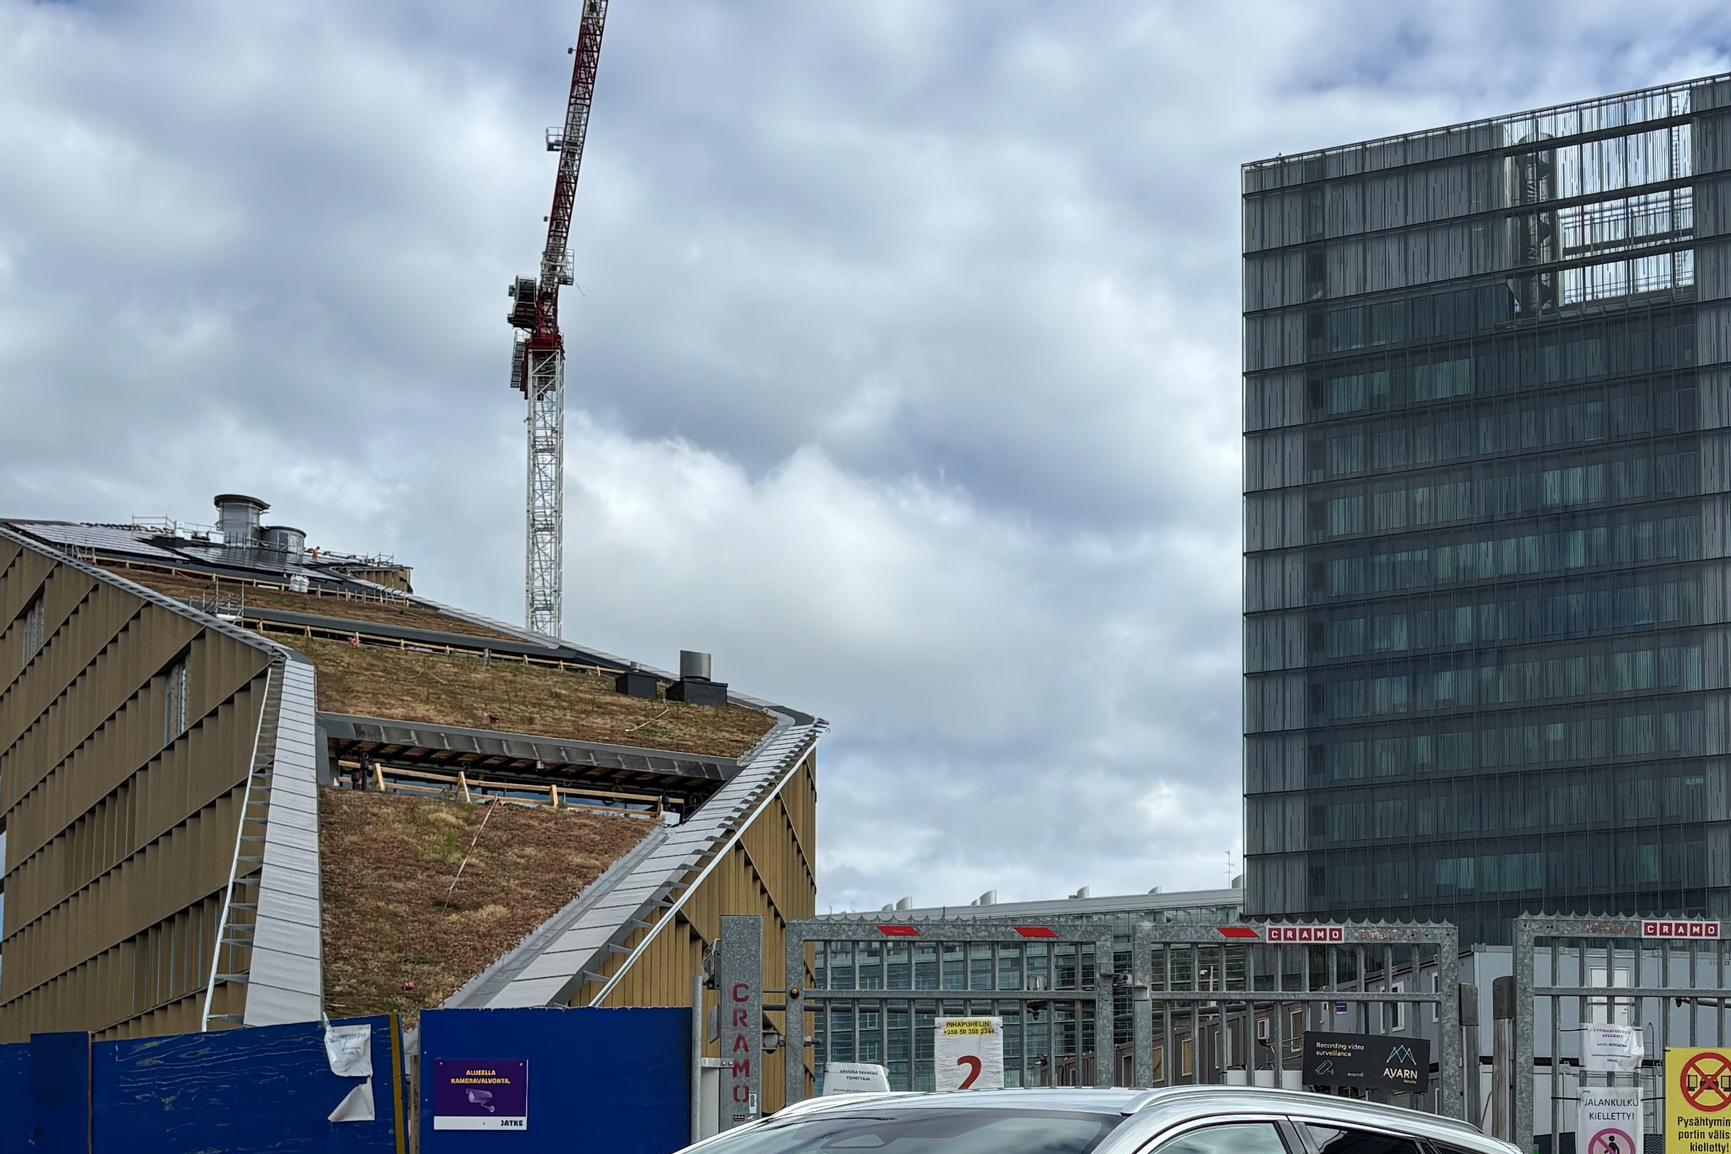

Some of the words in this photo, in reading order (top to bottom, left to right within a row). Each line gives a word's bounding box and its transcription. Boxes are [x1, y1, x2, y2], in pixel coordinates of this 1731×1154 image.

[1270, 929, 1340, 940] CRAMO
[1646, 925, 1715, 935] CRAMO
[732, 983, 750, 1103] CRAMO
[1316, 1042, 1347, 1051] Recording
[957, 1055, 982, 1090] 2
[1383, 1067, 1418, 1079] AVARN
[1584, 1098, 1639, 1107] JALANKULKU
[1589, 1112, 1635, 1121] KIELLETTY!
[500, 1119, 524, 1127] JATKE
[1678, 1129, 1705, 1140] portin
[1708, 1129, 1731, 1140] välis
[1689, 1142, 1729, 1154] kielletty!
